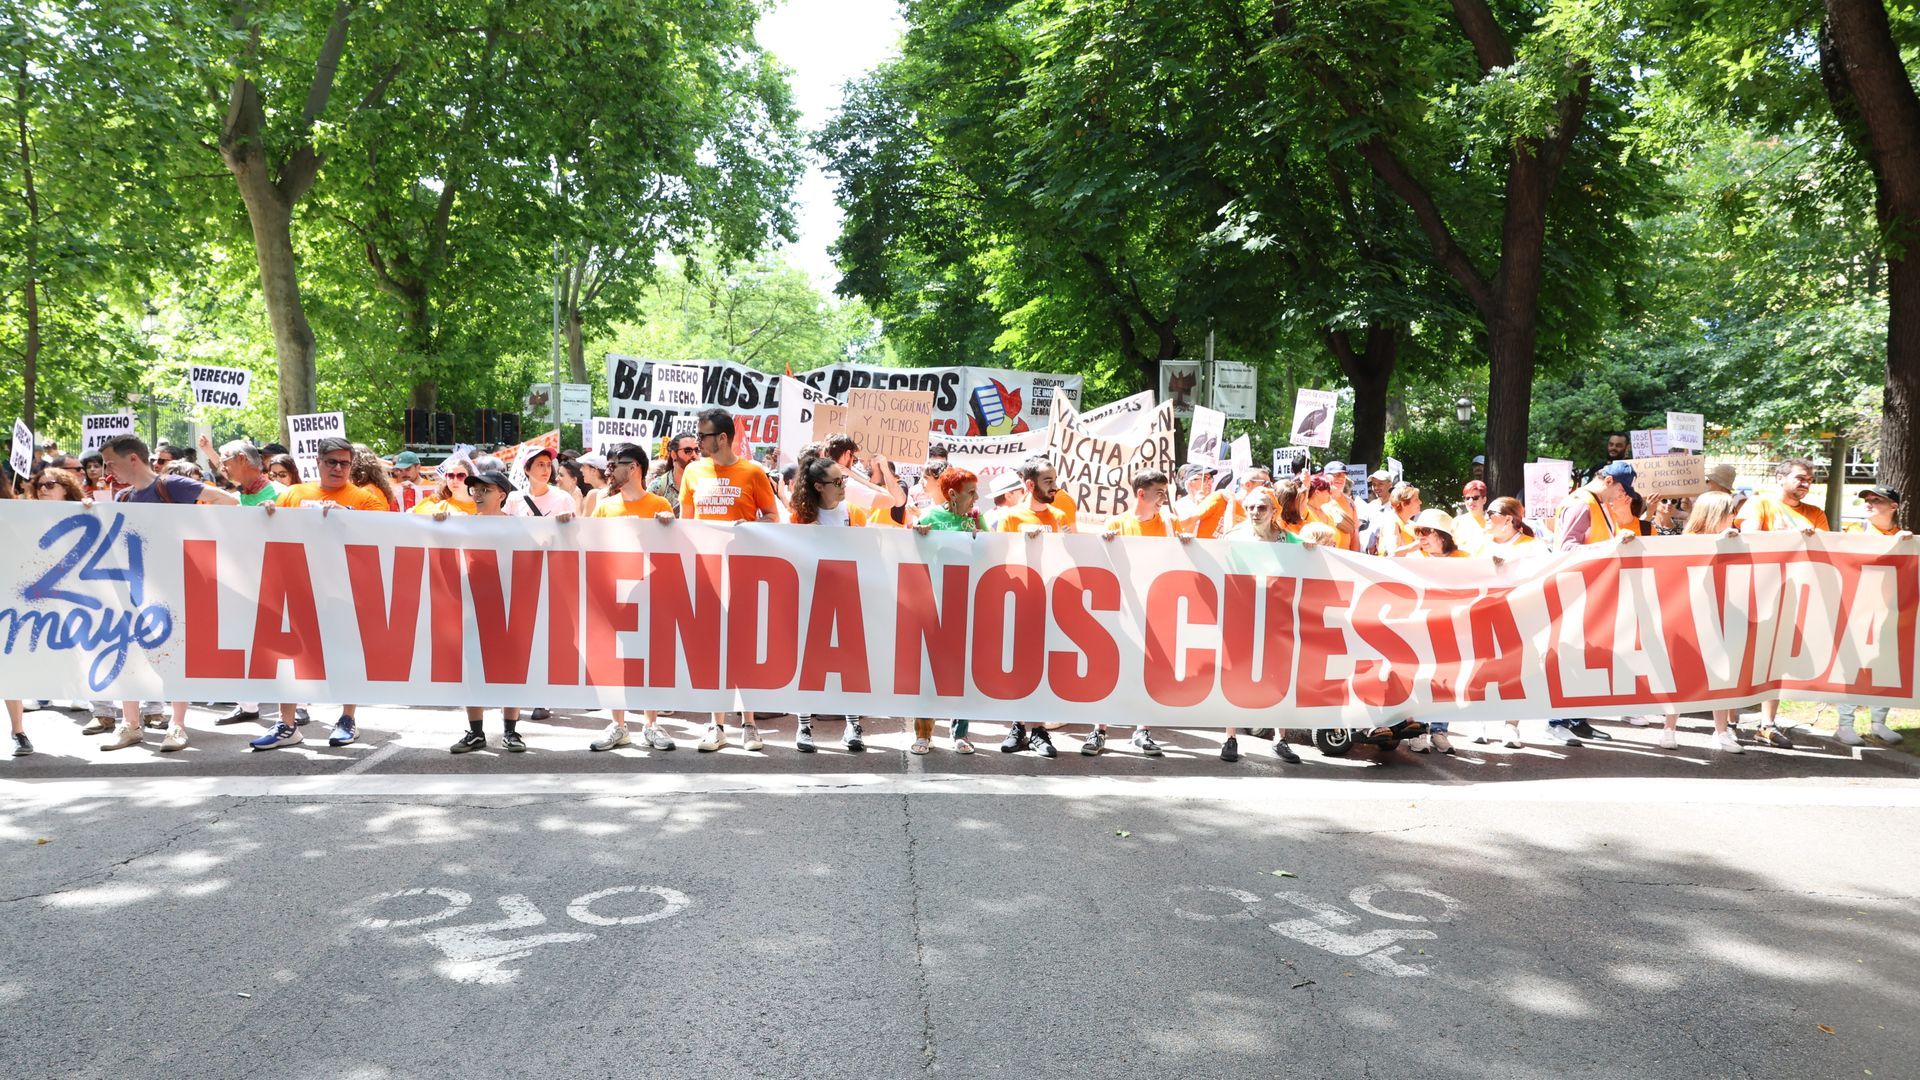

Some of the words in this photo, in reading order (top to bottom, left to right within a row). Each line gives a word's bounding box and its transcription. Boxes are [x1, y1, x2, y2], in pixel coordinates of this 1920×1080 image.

[193, 368, 245, 386] DERECHO
[658, 368, 699, 385] DERECHO
[1033, 378, 1064, 388] SINDICATO
[201, 389, 241, 406] TECHO.
[659, 391, 665, 402] A
[669, 392, 698, 405] TECHO.
[87, 416, 130, 430] DERECHO
[293, 416, 338, 432] DERECHO
[598, 420, 648, 438] DERECHO
[864, 416, 872, 426] Y
[880, 418, 920, 434] MENOS
[88, 438, 94, 448] A
[298, 440, 304, 454] A
[600, 442, 606, 456] A
[853, 431, 924, 458] BUITRES
[1050, 422, 1122, 466] LUCHA
[1276, 450, 1306, 460] DERECHO
[1278, 464, 1282, 474] A
[1654, 468, 1692, 477] PRECIOS
[1652, 479, 1700, 488] CORREDOR
[704, 506, 728, 515] MADRID
[20, 512, 146, 608] 24
[183, 539, 327, 680] LA
[344, 544, 872, 694] VIVIENDA
[894, 562, 1122, 703] NOS
[1143, 569, 1527, 710] CUESTA
[1555, 566, 1678, 699] LA
[1687, 561, 1904, 691] VIDA
[0, 600, 174, 693] mayo
